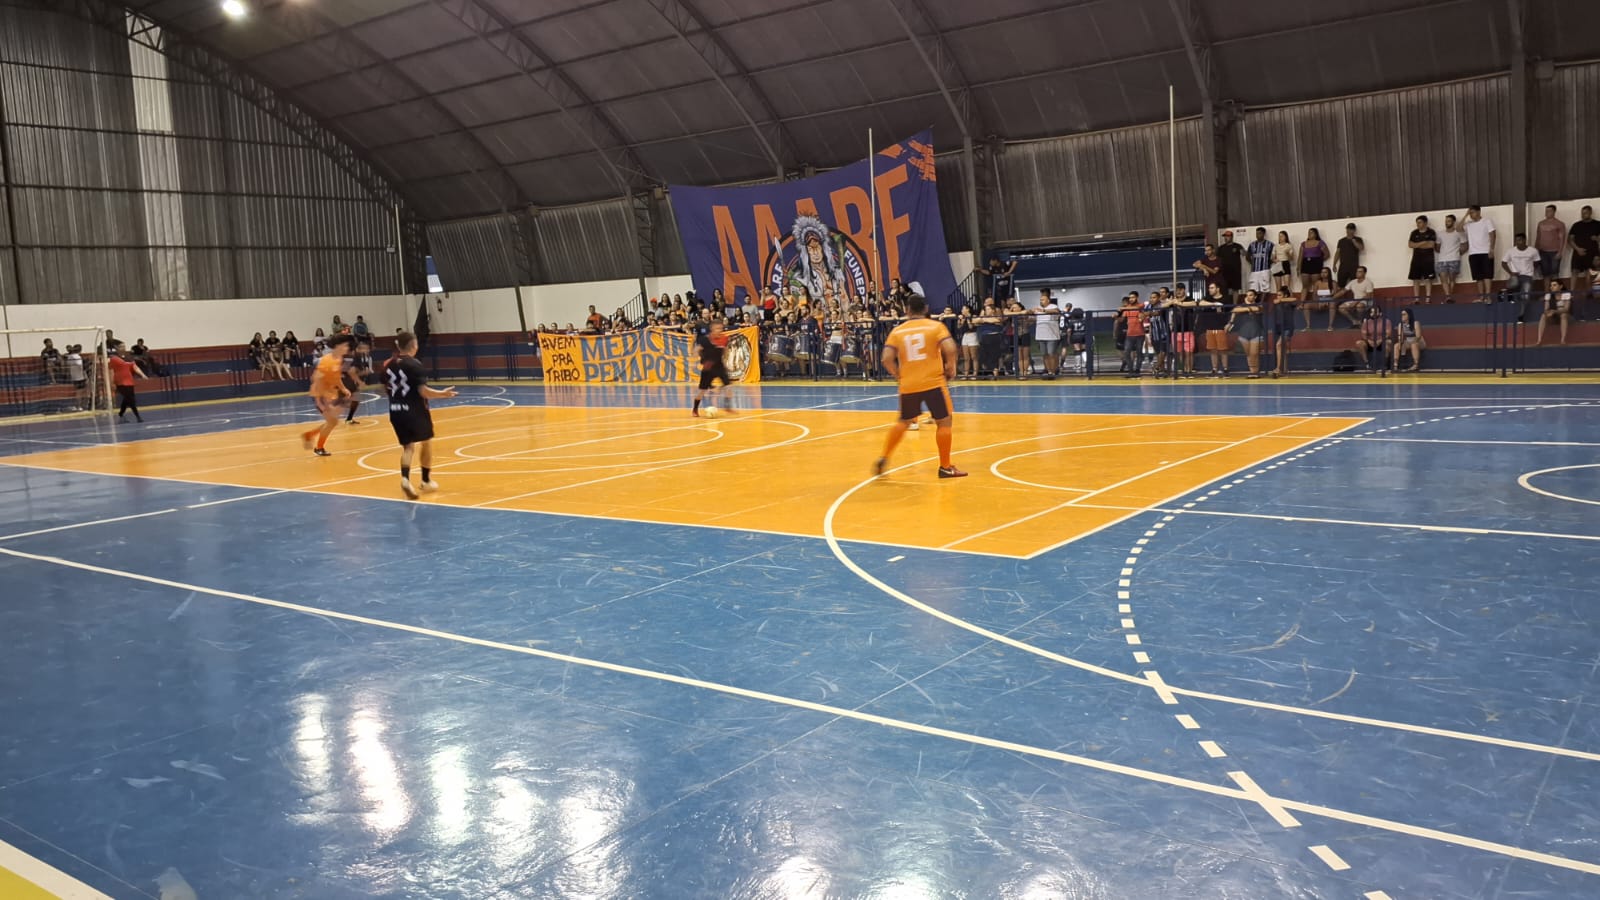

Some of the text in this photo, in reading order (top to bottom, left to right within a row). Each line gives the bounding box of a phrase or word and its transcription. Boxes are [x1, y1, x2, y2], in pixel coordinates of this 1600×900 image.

[541, 336, 576, 350] #VEM
[580, 328, 689, 361] MEDICIN
[904, 333, 927, 362] 12
[552, 352, 575, 367] PRA
[546, 367, 580, 382] TRIBO
